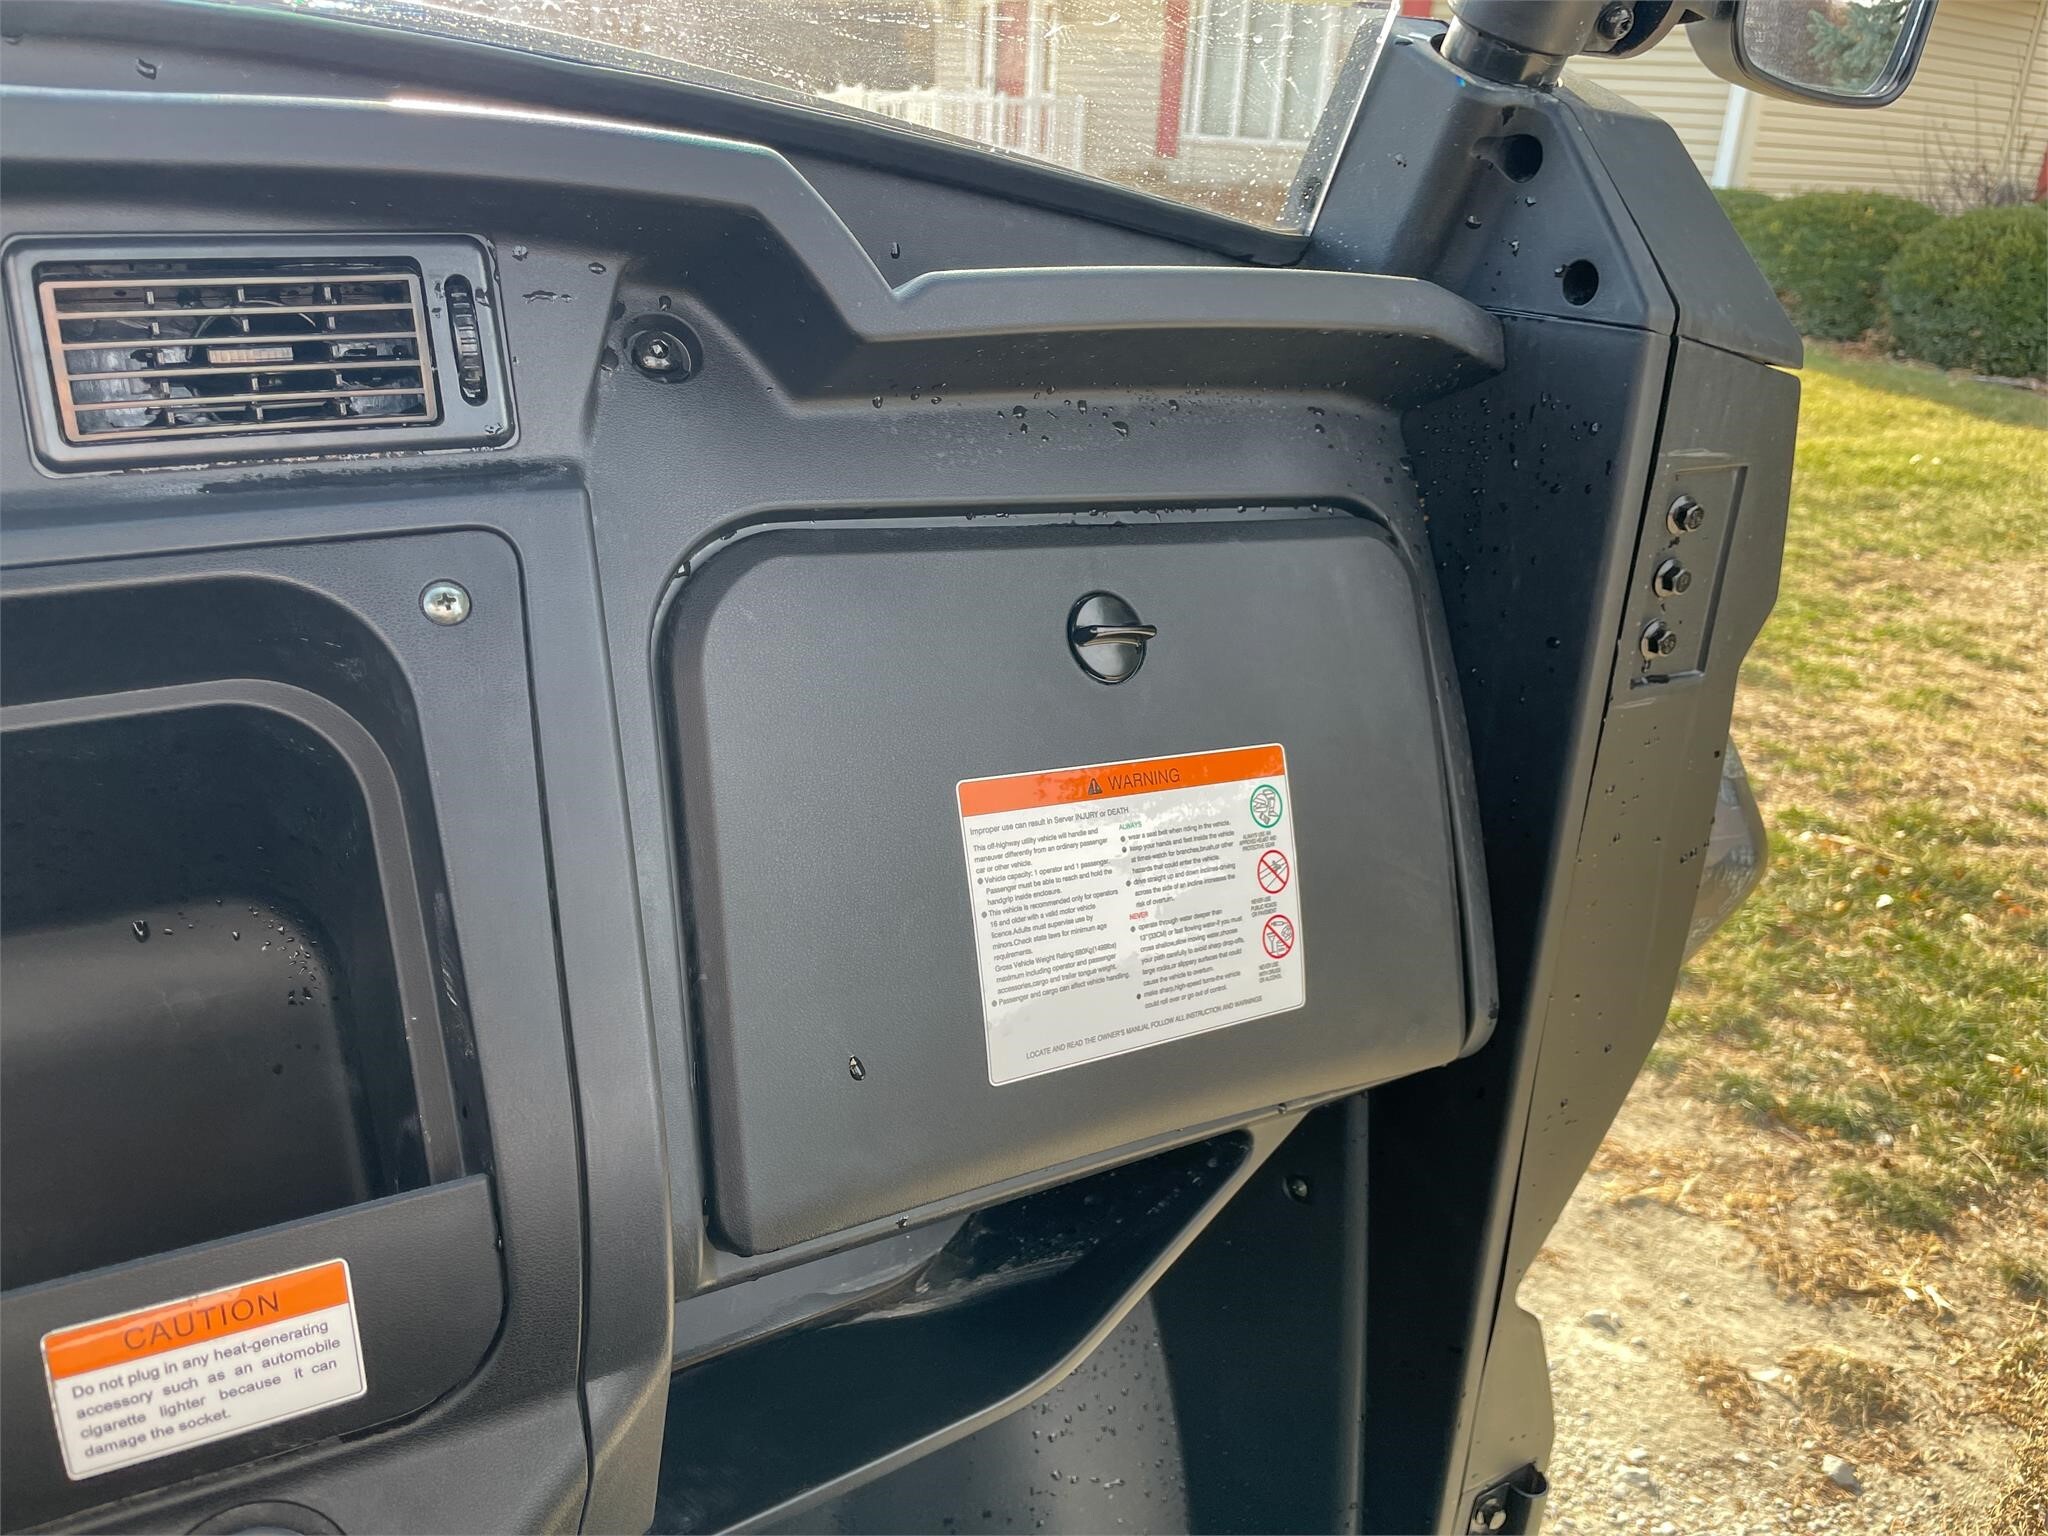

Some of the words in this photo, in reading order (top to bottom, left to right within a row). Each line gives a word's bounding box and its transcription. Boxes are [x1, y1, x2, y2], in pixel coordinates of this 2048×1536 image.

[1107, 767, 1180, 791] WARNING
[969, 825, 1000, 836] Improper
[1028, 818, 1046, 827] result
[1046, 817, 1053, 825] in
[1054, 815, 1074, 824] Server
[1075, 810, 1099, 821] INJURY
[1107, 806, 1129, 816] DEATH
[1119, 821, 1142, 830] ALWAYS
[973, 844, 986, 852] This
[1021, 837, 1036, 845] utility
[1037, 834, 1057, 842] vehicle
[1067, 830, 1087, 838] handle
[1087, 827, 1099, 835] and
[974, 853, 1003, 863] maneuver
[1004, 848, 1033, 859] differently
[1056, 842, 1079, 851] ordinary
[1079, 838, 1108, 849] passenger
[984, 875, 1006, 884] Vehicle
[1039, 866, 1063, 876] operator
[1064, 863, 1075, 871] and
[994, 863, 1010, 871] other
[986, 884, 1017, 895] Passenger
[1018, 881, 1033, 889] must
[1042, 878, 1055, 886] able
[1062, 874, 1078, 882] reach
[1090, 869, 1103, 877] hold
[987, 896, 1014, 906] handgrip
[1014, 893, 1032, 901] inside
[988, 909, 1002, 917] This
[1002, 905, 1023, 914] vehicle
[1029, 896, 1071, 909] recommended
[1071, 894, 1083, 903] only
[1092, 889, 1119, 899] operators
[990, 920, 998, 928] 16
[999, 918, 1011, 926] and
[1011, 916, 1026, 924] older
[1027, 913, 1039, 921] with
[1045, 909, 1059, 918] valid
[1059, 907, 1076, 915] motor
[1076, 903, 1096, 912] vehicle
[1032, 923, 1047, 931] must
[1047, 918, 1074, 929] supervise
[1129, 911, 1148, 920] NEVER
[1070, 925, 1096, 935] minimum
[1097, 923, 1107, 931] age
[994, 964, 1013, 972] Gross
[1013, 959, 1035, 968] Vehicle
[1035, 954, 1056, 964] Weight
[996, 972, 1025, 983] maximum
[1025, 967, 1052, 977] including
[1052, 962, 1076, 972] operator
[1076, 958, 1087, 967] and
[1088, 953, 1116, 966] passenger
[998, 994, 1029, 1006] Passenger
[1030, 990, 1041, 999] and
[1042, 988, 1059, 996] cargo
[1071, 981, 1086, 990] affect
[1086, 977, 1105, 986] vehicle
[1026, 1047, 1052, 1060] LOCATE
[1052, 1043, 1066, 1053] AND
[1066, 1039, 1083, 1050] READ
[1084, 1035, 1096, 1045] THE
[1126, 1023, 1150, 1034] MANUAL
[1150, 1016, 1174, 1029] FOLLOW
[1185, 1006, 1222, 1020] INSTRUCTION
[1222, 1002, 1234, 1011] AND
[124, 1291, 279, 1350] CAUTION
[72, 1385, 95, 1399] Do
[99, 1376, 124, 1392] not
[127, 1368, 160, 1387] plug
[164, 1363, 178, 1375] in
[182, 1354, 209, 1370] any
[213, 1322, 328, 1361] heat-generating
[77, 1391, 153, 1420] accessory
[162, 1377, 199, 1396] such
[208, 1371, 225, 1384] as
[234, 1364, 253, 1376] an
[262, 1339, 340, 1368] automobile
[80, 1414, 146, 1439] cigarette
[159, 1396, 205, 1417] lighter
[219, 1376, 281, 1400] because
[294, 1368, 303, 1379] it
[311, 1360, 337, 1374] can
[84, 1434, 146, 1457] damage
[150, 1426, 174, 1440] the
[178, 1409, 231, 1431] socket.
